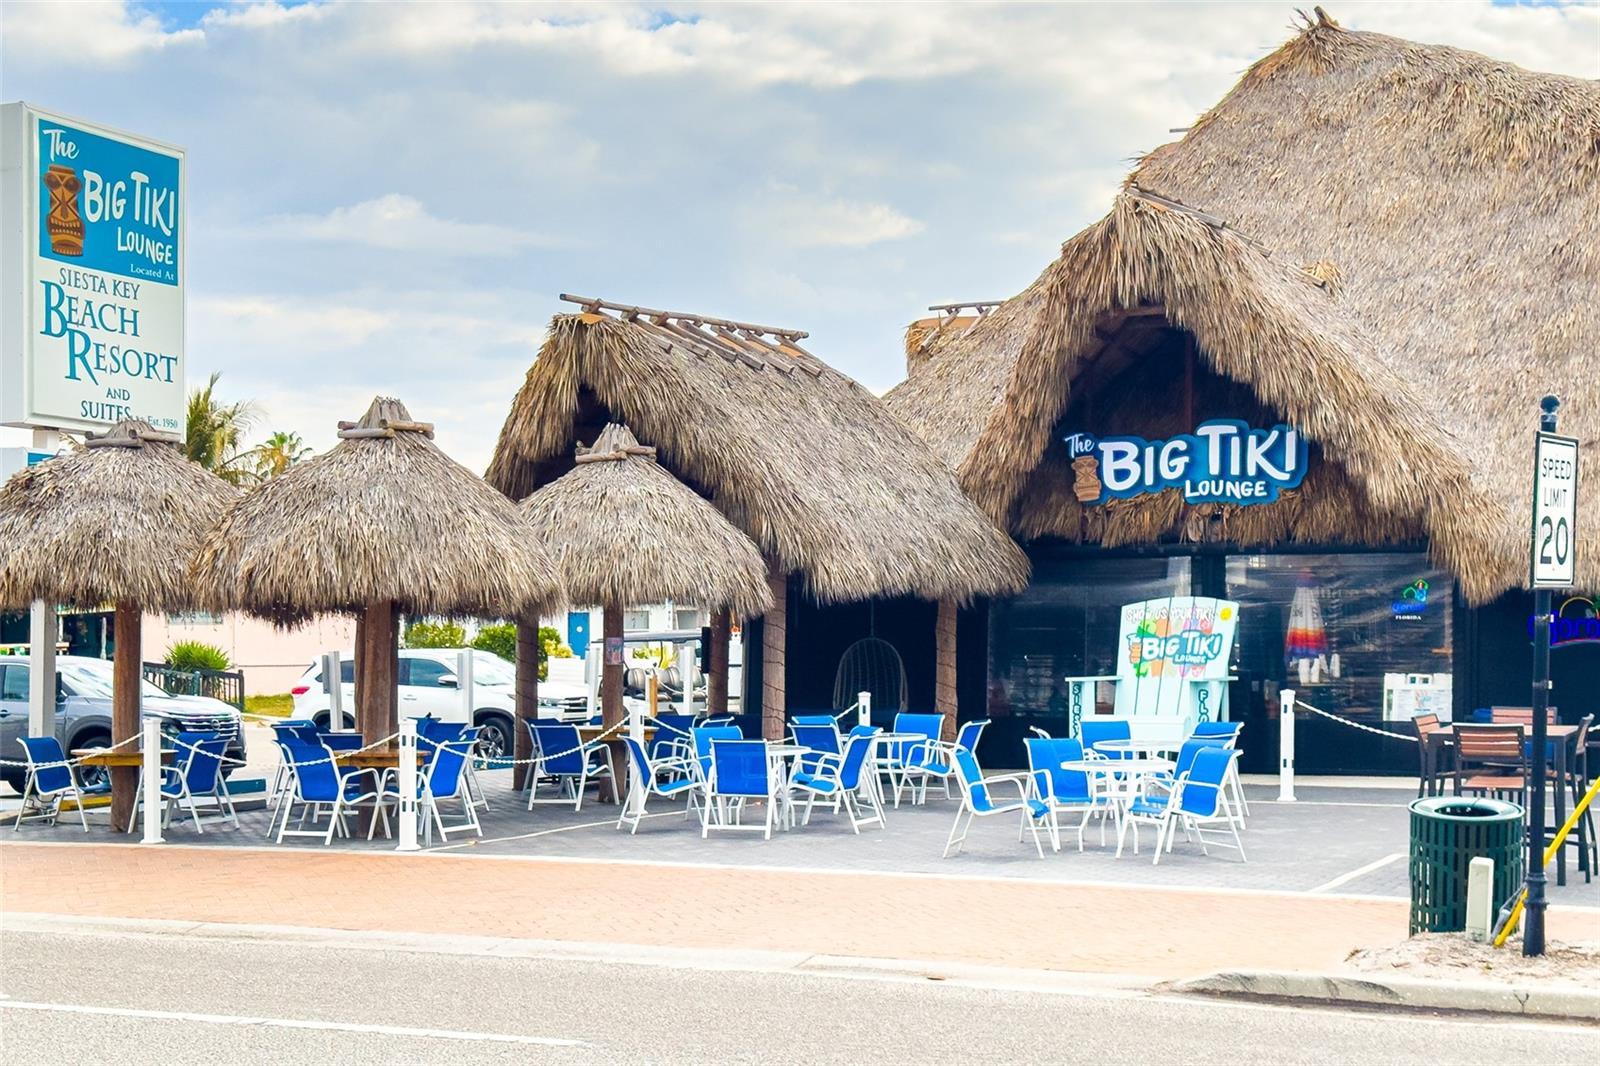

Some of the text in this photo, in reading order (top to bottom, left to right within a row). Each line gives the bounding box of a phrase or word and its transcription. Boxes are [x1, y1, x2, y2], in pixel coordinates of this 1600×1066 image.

[43, 129, 80, 161] The
[83, 169, 175, 236] BIG TIKI
[117, 226, 174, 265] LOUNGE
[60, 267, 141, 300] SIESTA KEY
[130, 263, 175, 281] Located At
[40, 280, 140, 338] BEACH
[65, 328, 178, 386] RESORT
[106, 387, 130, 401] AND
[163, 419, 178, 429] 1950
[1064, 433, 1095, 458] The
[1098, 424, 1296, 491] BIG TIKI
[1542, 457, 1572, 480] SPEED
[1185, 479, 1268, 499] LOUNGE
[1544, 487, 1567, 507] LIMIT
[1540, 515, 1568, 565] 20
[1142, 631, 1223, 661] BIG TIKI
